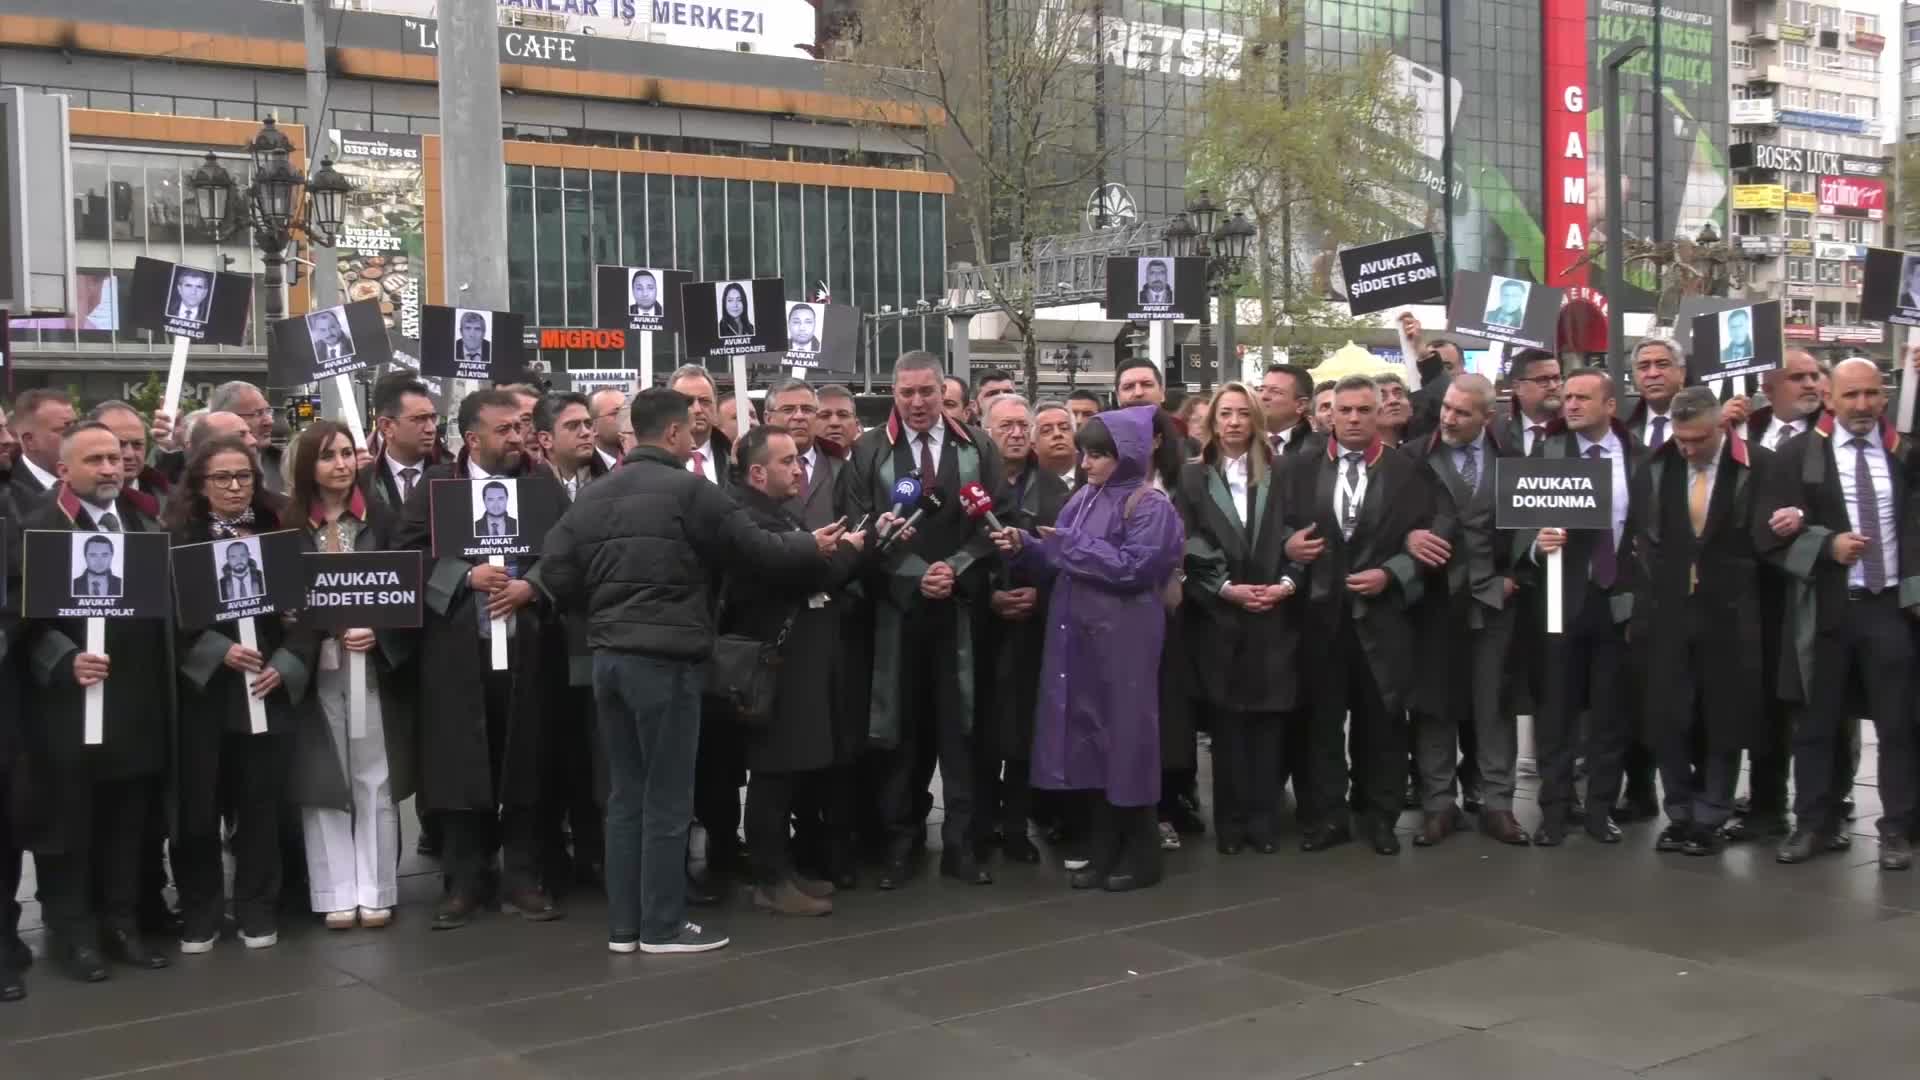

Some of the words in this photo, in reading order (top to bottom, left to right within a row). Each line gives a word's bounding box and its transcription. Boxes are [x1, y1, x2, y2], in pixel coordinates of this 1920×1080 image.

[405, 19, 417, 30] by
[505, 32, 577, 62] CAFE
[343, 144, 369, 155] 0312
[370, 146, 388, 156] 417
[404, 149, 417, 158] 63
[1756, 144, 1802, 171] ROSE'S
[1807, 151, 1840, 176] LUCK
[1563, 84, 1586, 250] GAMA
[345, 225, 391, 236] burada
[335, 234, 402, 250] LEZZET
[358, 247, 380, 257] var
[1360, 252, 1423, 276] AVUKATA
[1351, 272, 1407, 298] ŞİDDETE
[1407, 265, 1438, 282] SON
[169, 318, 201, 329] AVUKAT
[724, 337, 751, 346] AVUKAT
[710, 346, 735, 355] HATİCE
[735, 345, 766, 353] KOCAEFE
[324, 357, 352, 369] AVUKAT
[794, 359, 819, 367] ALKAN
[456, 369, 468, 377] ALİ
[468, 370, 489, 379] AYDIN
[1516, 476, 1593, 490] AVUKATA
[1512, 495, 1597, 508] DOKUNMA
[464, 546, 503, 555] ZEKERİYA
[315, 571, 400, 587] AVUKATA
[78, 598, 116, 606] AVUKAT
[228, 597, 261, 609] AVUKAT
[378, 590, 416, 605] SON
[58, 607, 103, 616] ZEKERİYA
[104, 608, 135, 616] POLAT
[216, 610, 240, 621] ERSİN
[241, 604, 275, 616] ARSLAN
